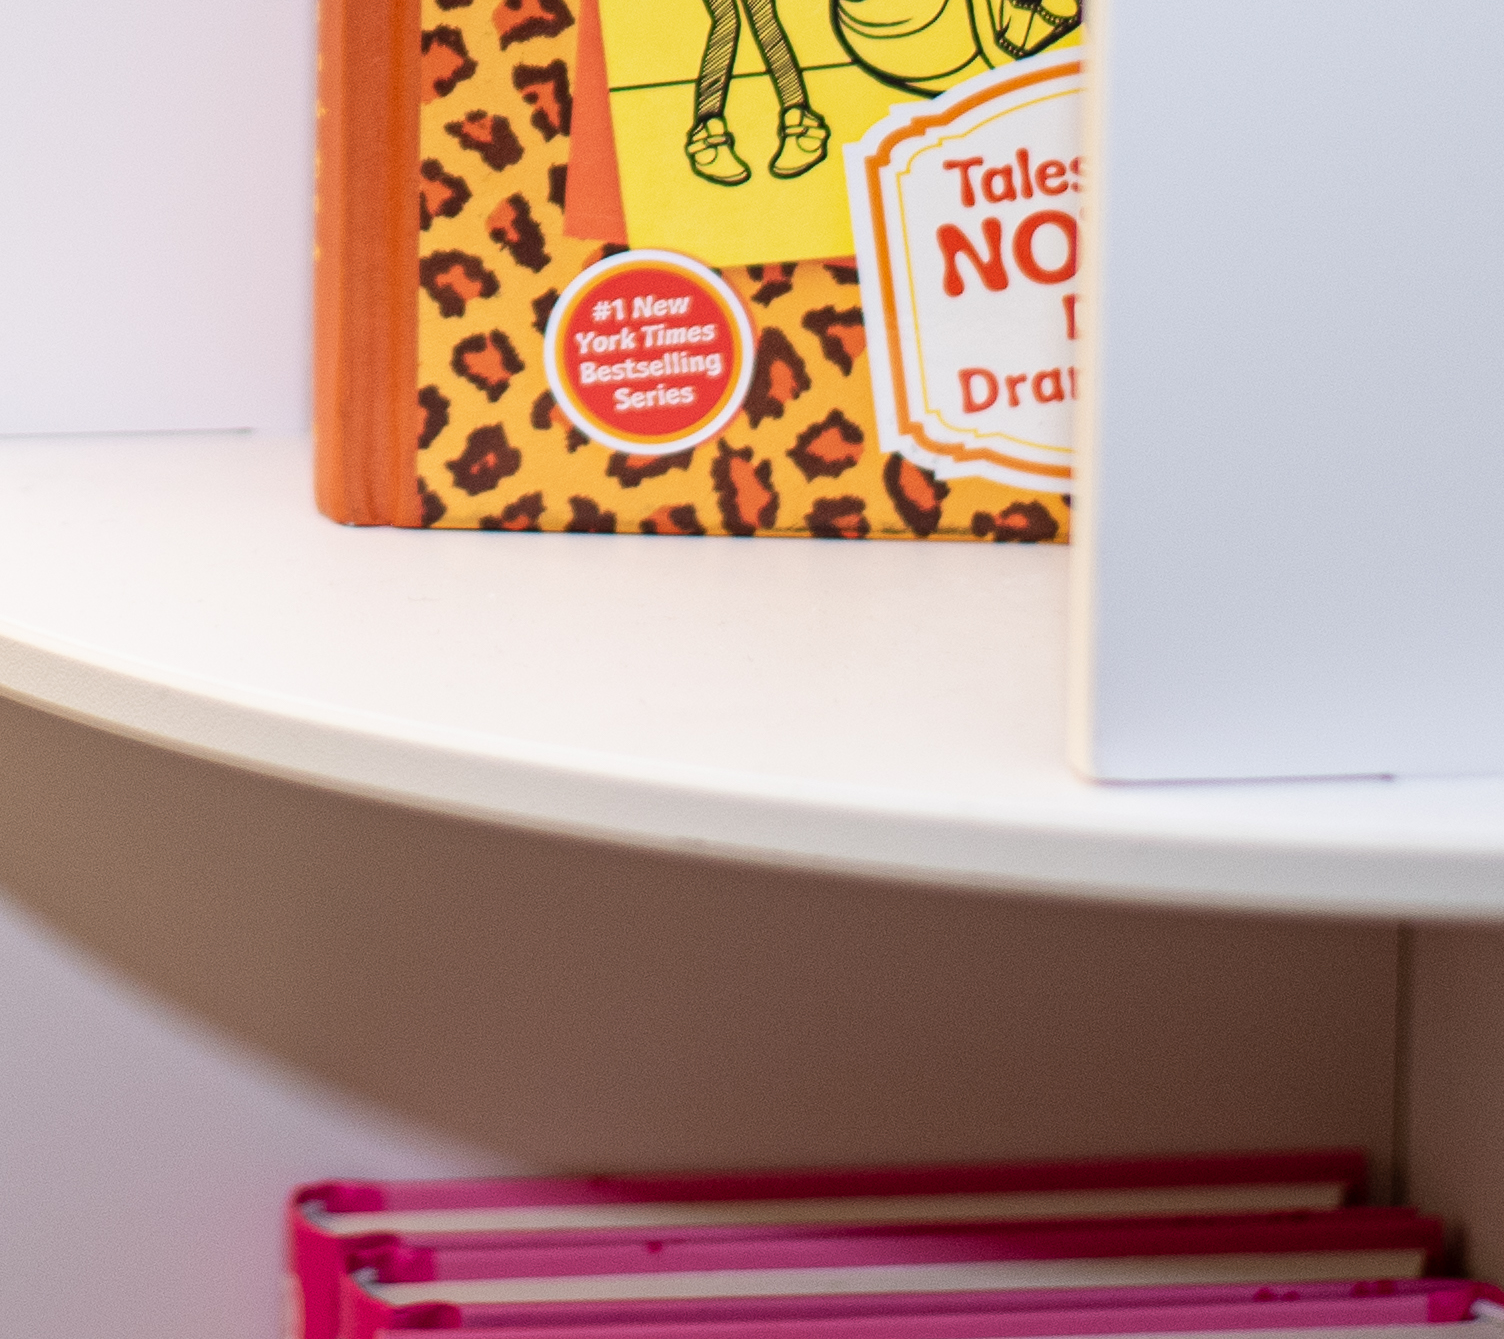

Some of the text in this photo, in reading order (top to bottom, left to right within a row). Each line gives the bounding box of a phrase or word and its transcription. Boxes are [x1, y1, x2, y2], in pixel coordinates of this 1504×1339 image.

[592, 295, 690, 321] #1 New
[575, 323, 715, 354] York Times
[579, 351, 722, 385] Bestselling
[614, 383, 695, 410] Series
